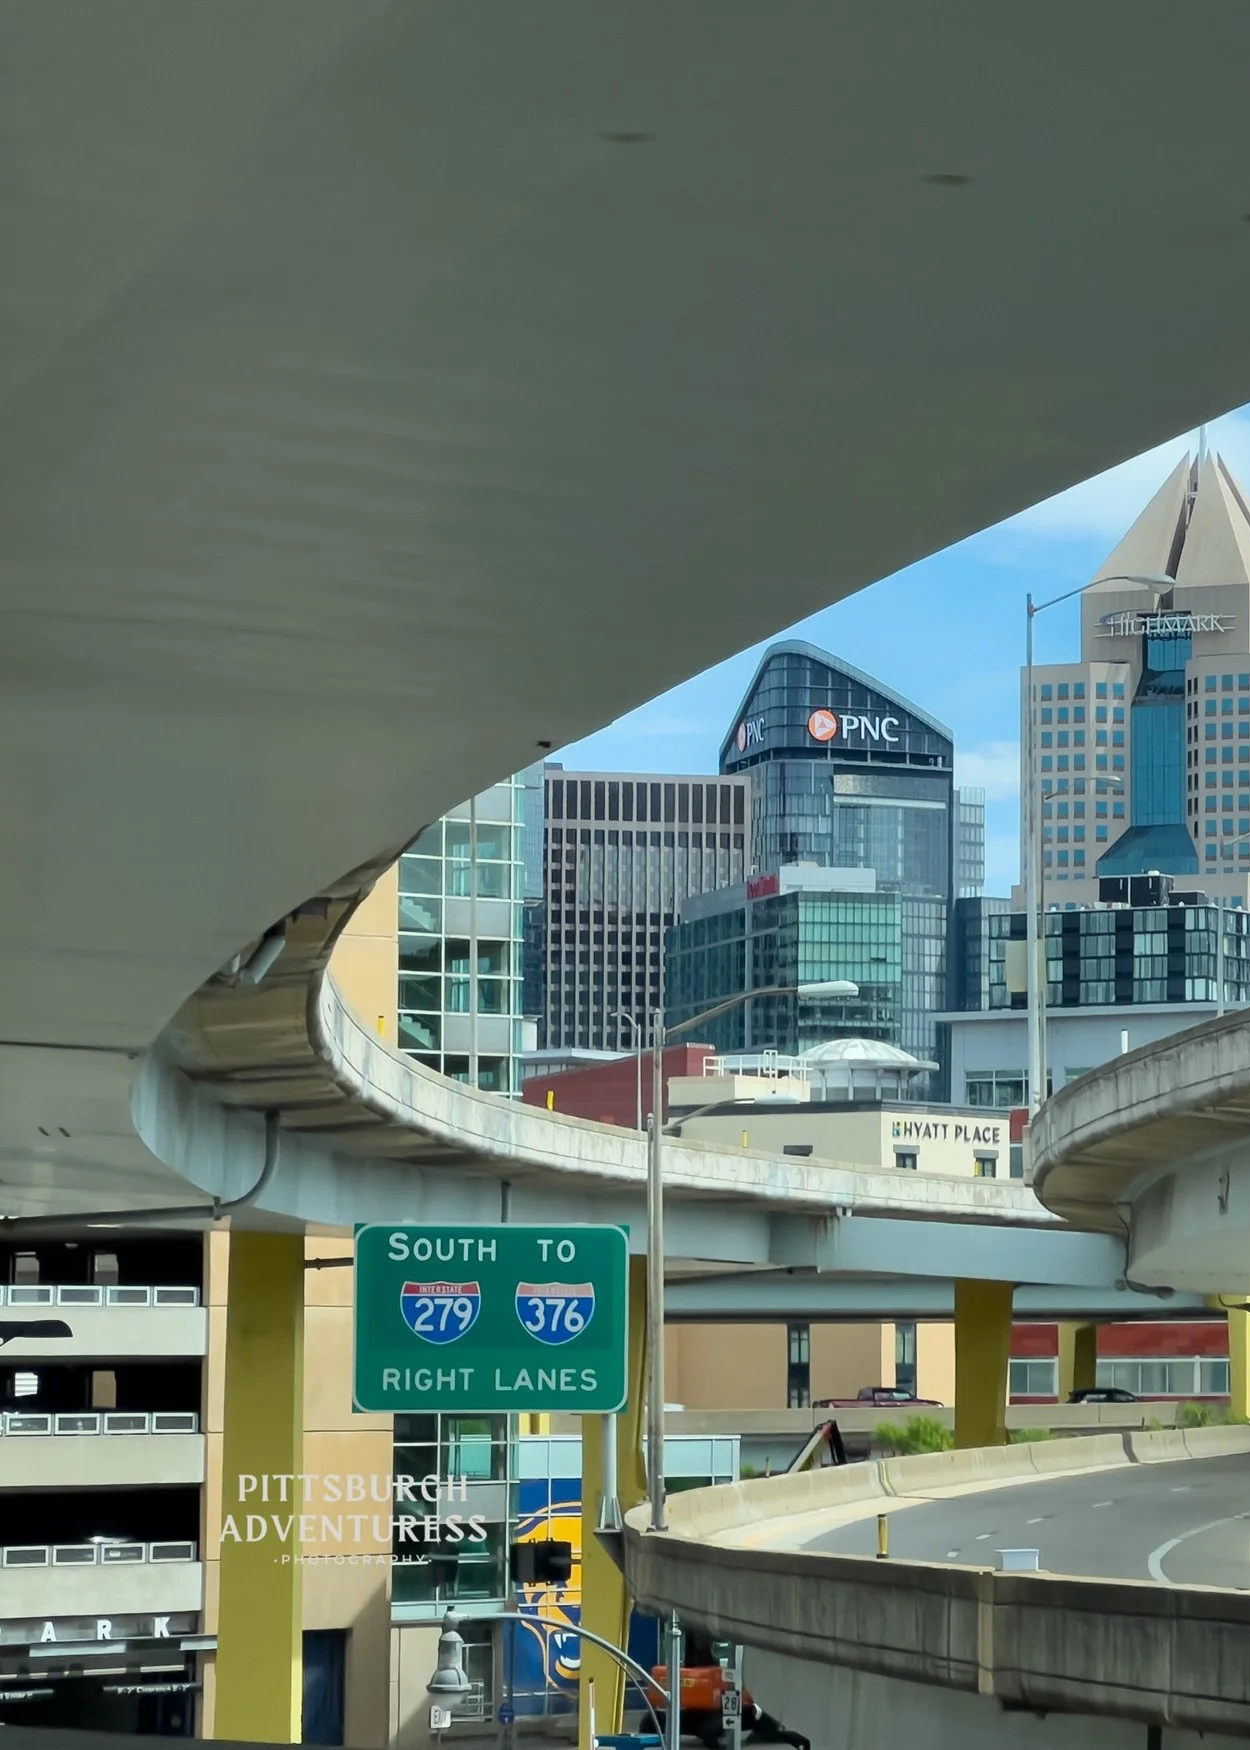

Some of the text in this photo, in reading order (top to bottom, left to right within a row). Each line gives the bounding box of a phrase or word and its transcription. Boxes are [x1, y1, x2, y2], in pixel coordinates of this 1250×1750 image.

[1110, 609, 1225, 637] HIGHMARK
[746, 717, 766, 747] PNC
[839, 714, 899, 742] PNC
[903, 1121, 1001, 1144] HYATT PLACE
[388, 1232, 576, 1263] SOUTH TO
[419, 1285, 462, 1294] INTERSTATE
[414, 1298, 473, 1332] 279
[525, 1298, 585, 1333] 376
[382, 1368, 598, 1391] RIGHT LANES
[0, 1616, 171, 1643] ARK
[724, 1695, 737, 1711] 28
